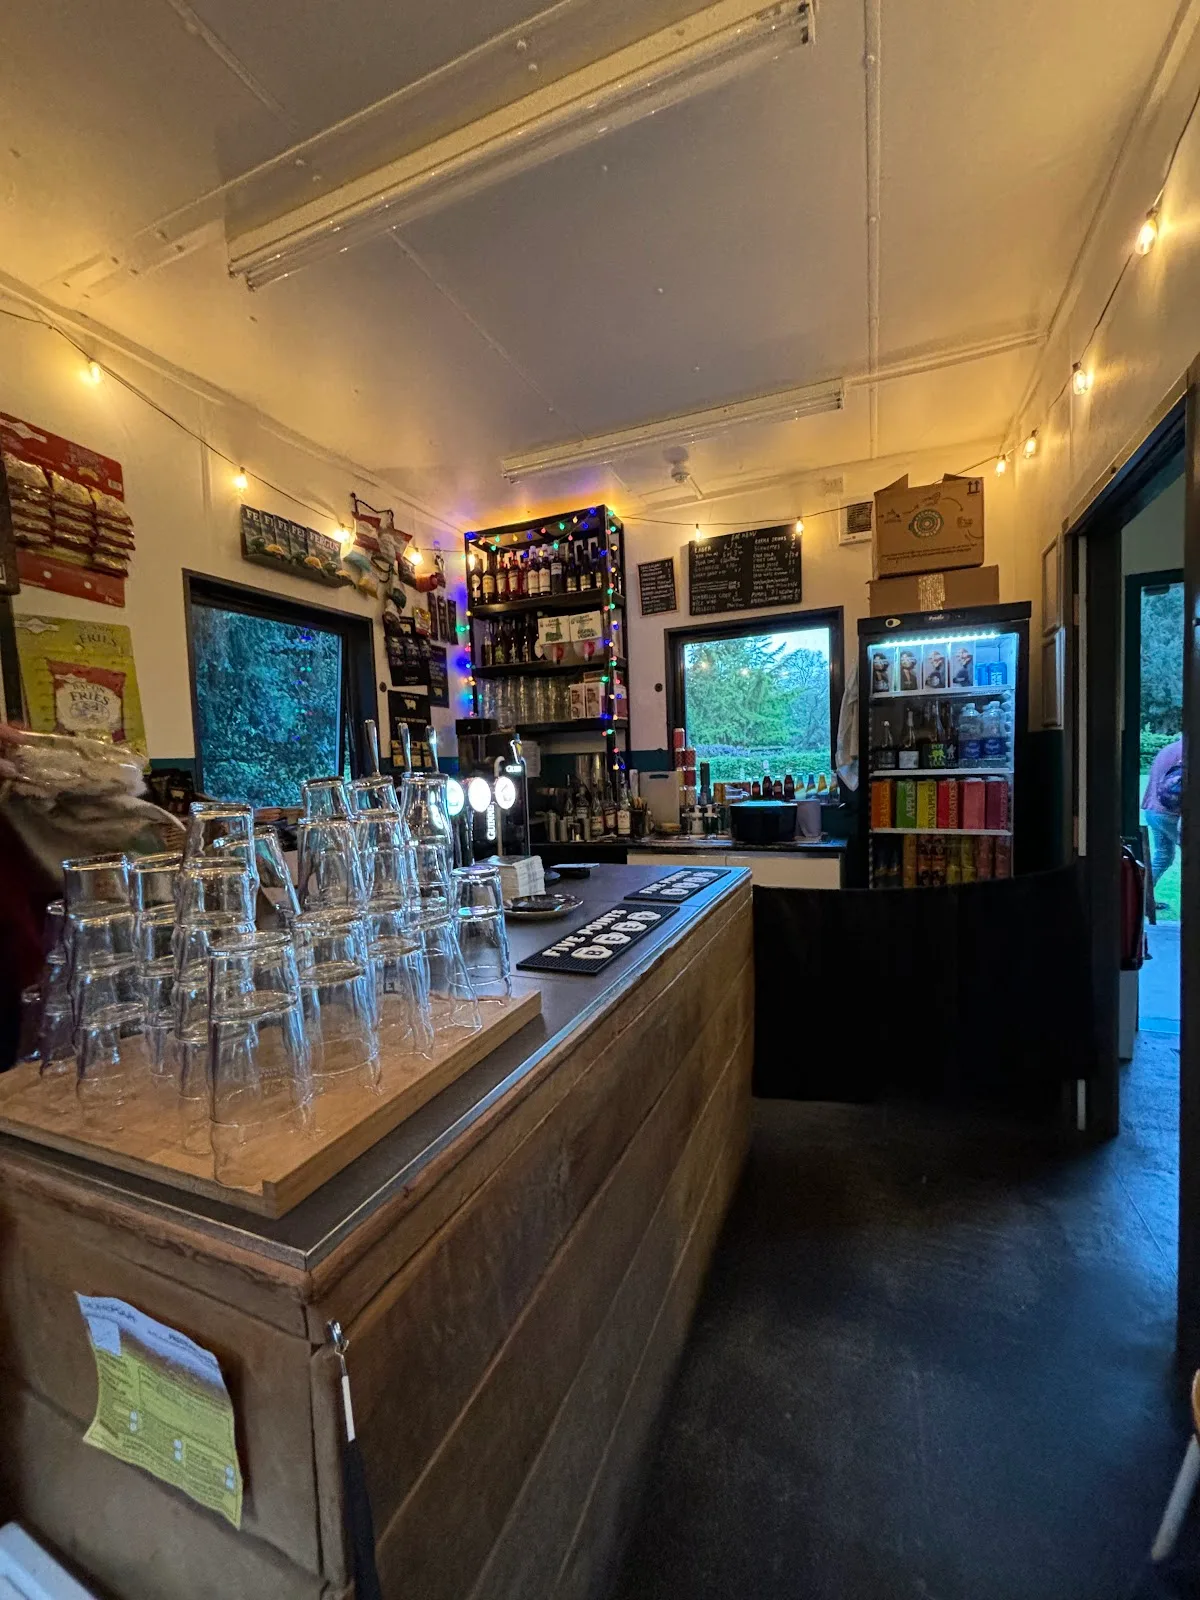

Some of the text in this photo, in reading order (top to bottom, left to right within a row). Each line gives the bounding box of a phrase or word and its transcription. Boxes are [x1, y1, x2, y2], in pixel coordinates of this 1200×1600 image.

[310, 531, 340, 551] FERGUS
[78, 634, 117, 647] FRIES
[70, 692, 110, 705] FRIES
[905, 781, 915, 818] APPLES
[948, 781, 958, 829] TOMATOES
[541, 909, 627, 957] FIVE POINTS
[577, 912, 658, 957] BEER
